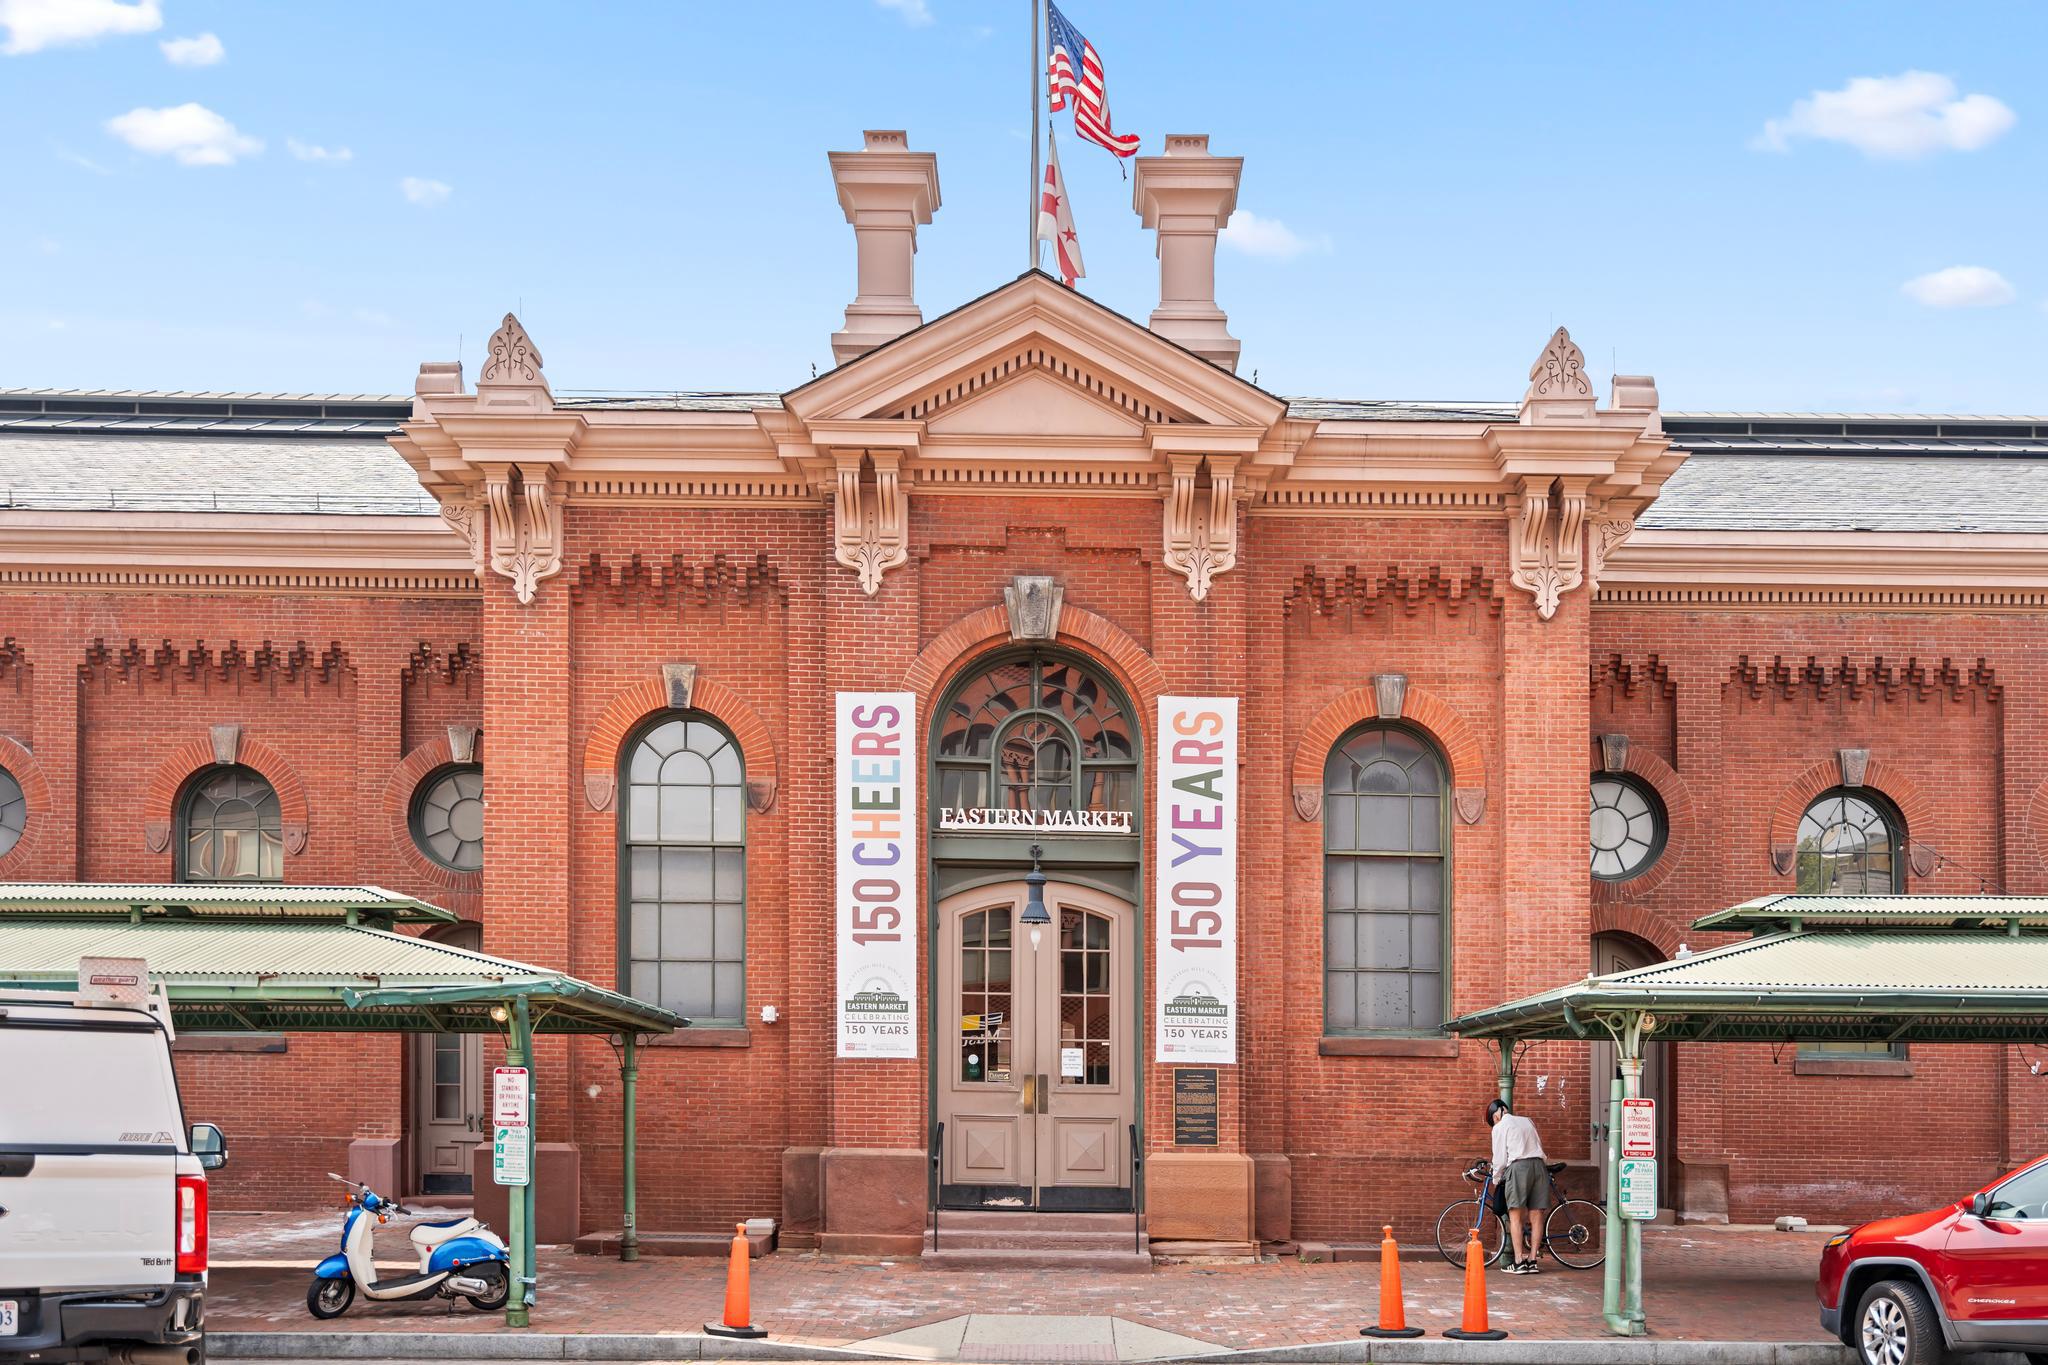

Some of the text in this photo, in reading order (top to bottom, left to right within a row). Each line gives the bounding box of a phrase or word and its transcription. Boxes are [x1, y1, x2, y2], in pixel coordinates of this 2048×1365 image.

[940, 807, 1133, 828] EASTERN MARKET
[851, 705, 901, 946] 150 CHEERS
[1170, 711, 1224, 953] 150 YEARS
[847, 1002, 907, 1011] EASTERN MARKET
[1166, 1006, 1226, 1015] EASTERN MARKET
[844, 1013, 910, 1021] CELEBRATING
[1163, 1016, 1229, 1025] CELEBRATING
[845, 1025, 909, 1035] 150 YEARS
[1164, 1028, 1228, 1039] 150 YEARS
[498, 1143, 503, 1153] 2
[1623, 1178, 1629, 1188] 2
[140, 1257, 173, 1266] Ted Britt
